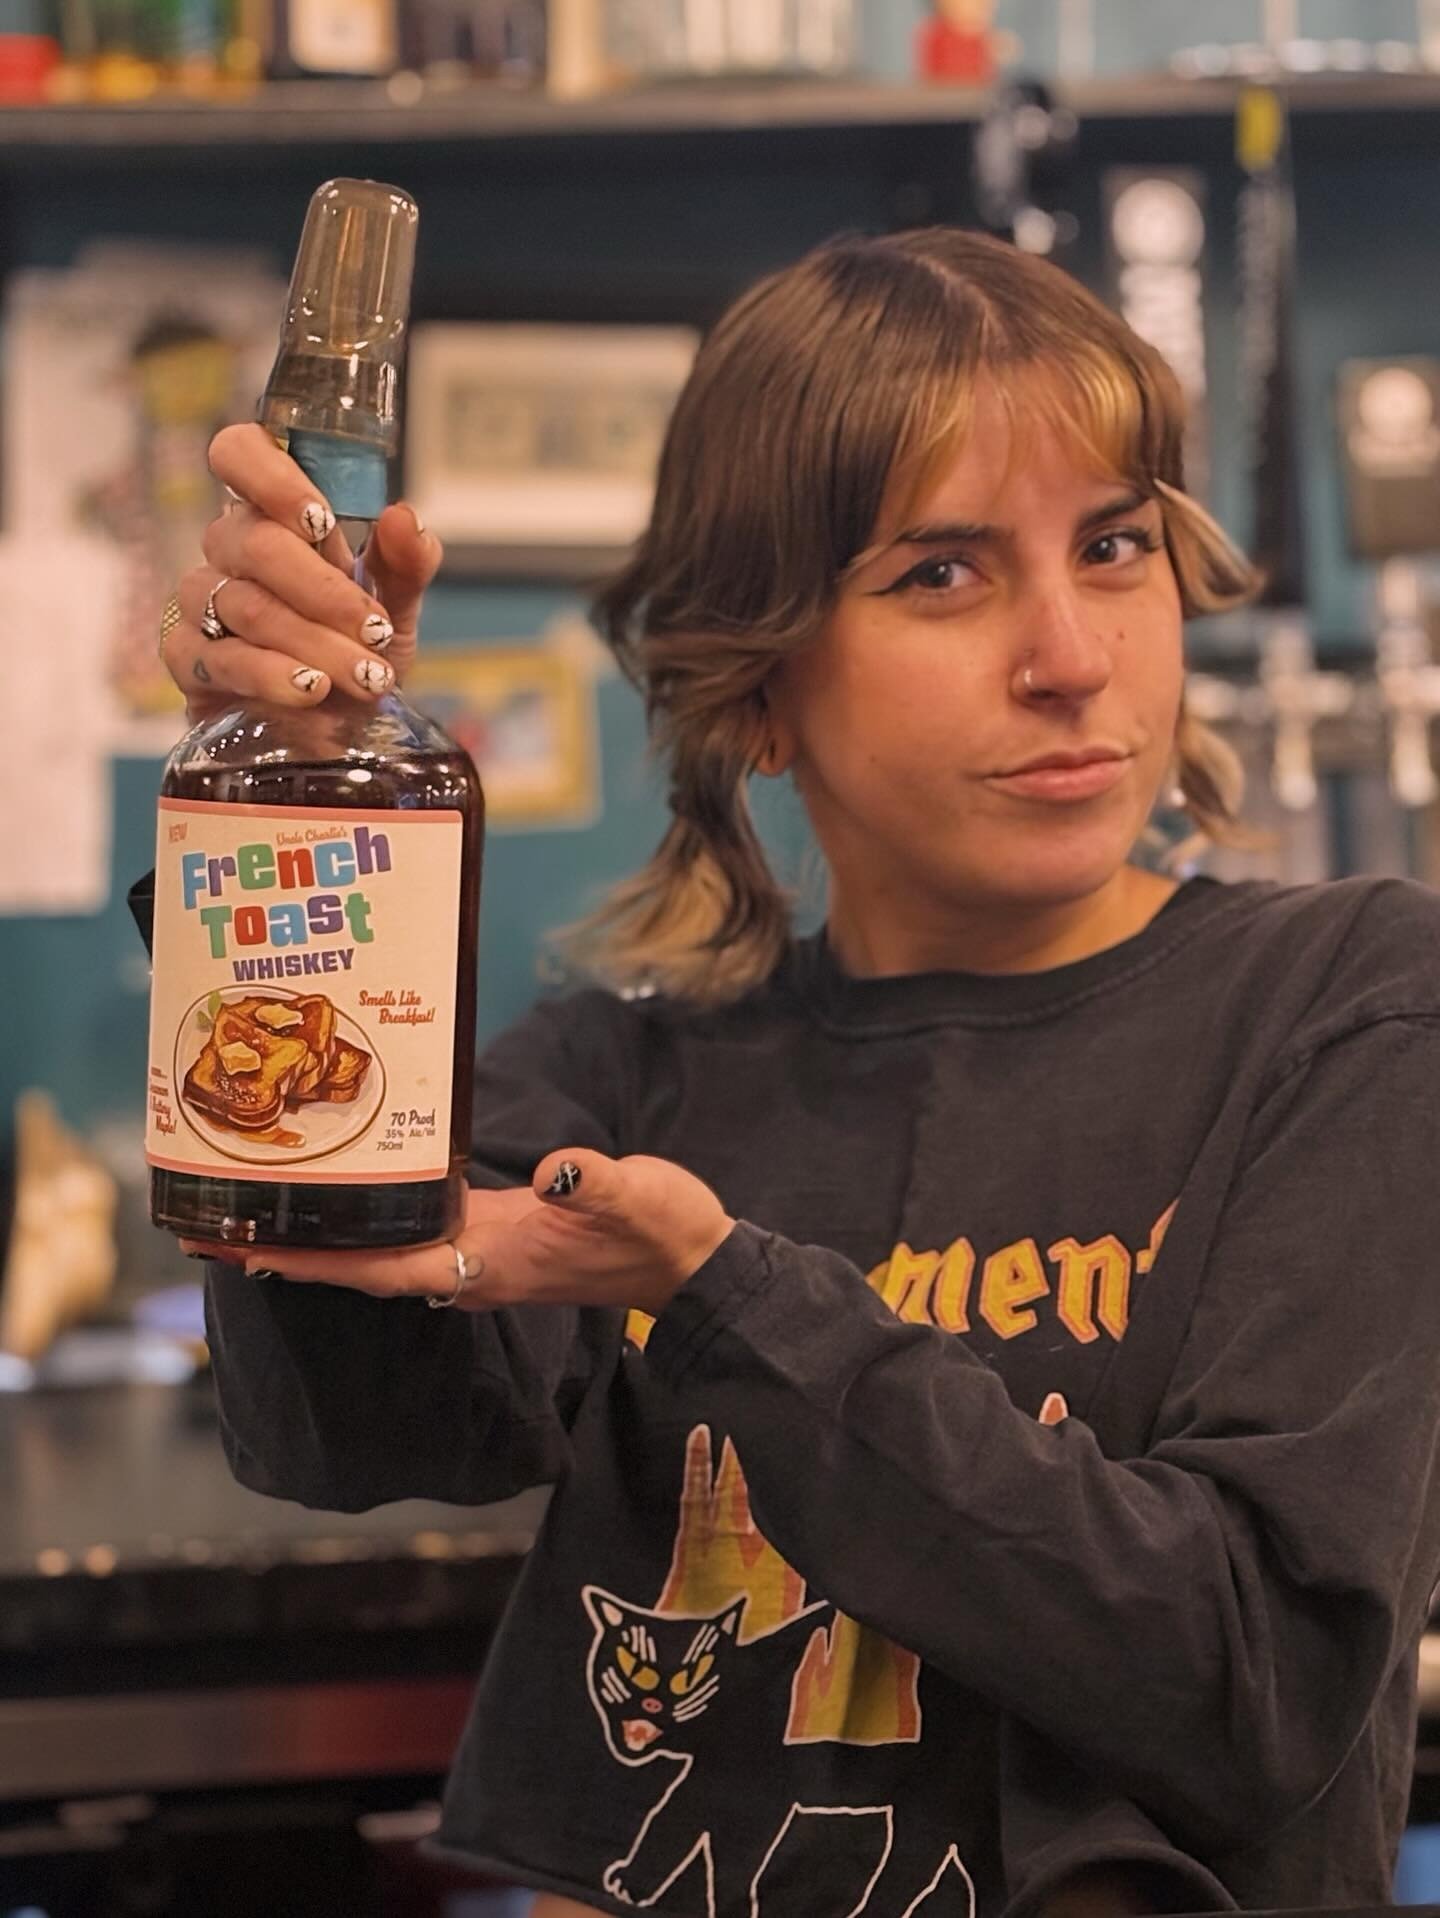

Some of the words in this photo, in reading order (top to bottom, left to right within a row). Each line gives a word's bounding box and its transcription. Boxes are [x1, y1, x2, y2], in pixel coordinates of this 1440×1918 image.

[276, 831, 304, 846] Uncle
[305, 826, 348, 843] Charlie's
[182, 826, 392, 910] French
[200, 892, 375, 959] Toast
[233, 948, 355, 982] WHISKEY
[359, 989, 396, 1007] Smells
[398, 989, 422, 1007] Like
[379, 1007, 436, 1027] Breakfast!
[391, 1111, 406, 1127] 70
[408, 1107, 436, 1127] Proof
[384, 1128, 405, 1139] 35%
[376, 1141, 403, 1151] 750ml
[865, 1198, 1180, 1344] men
